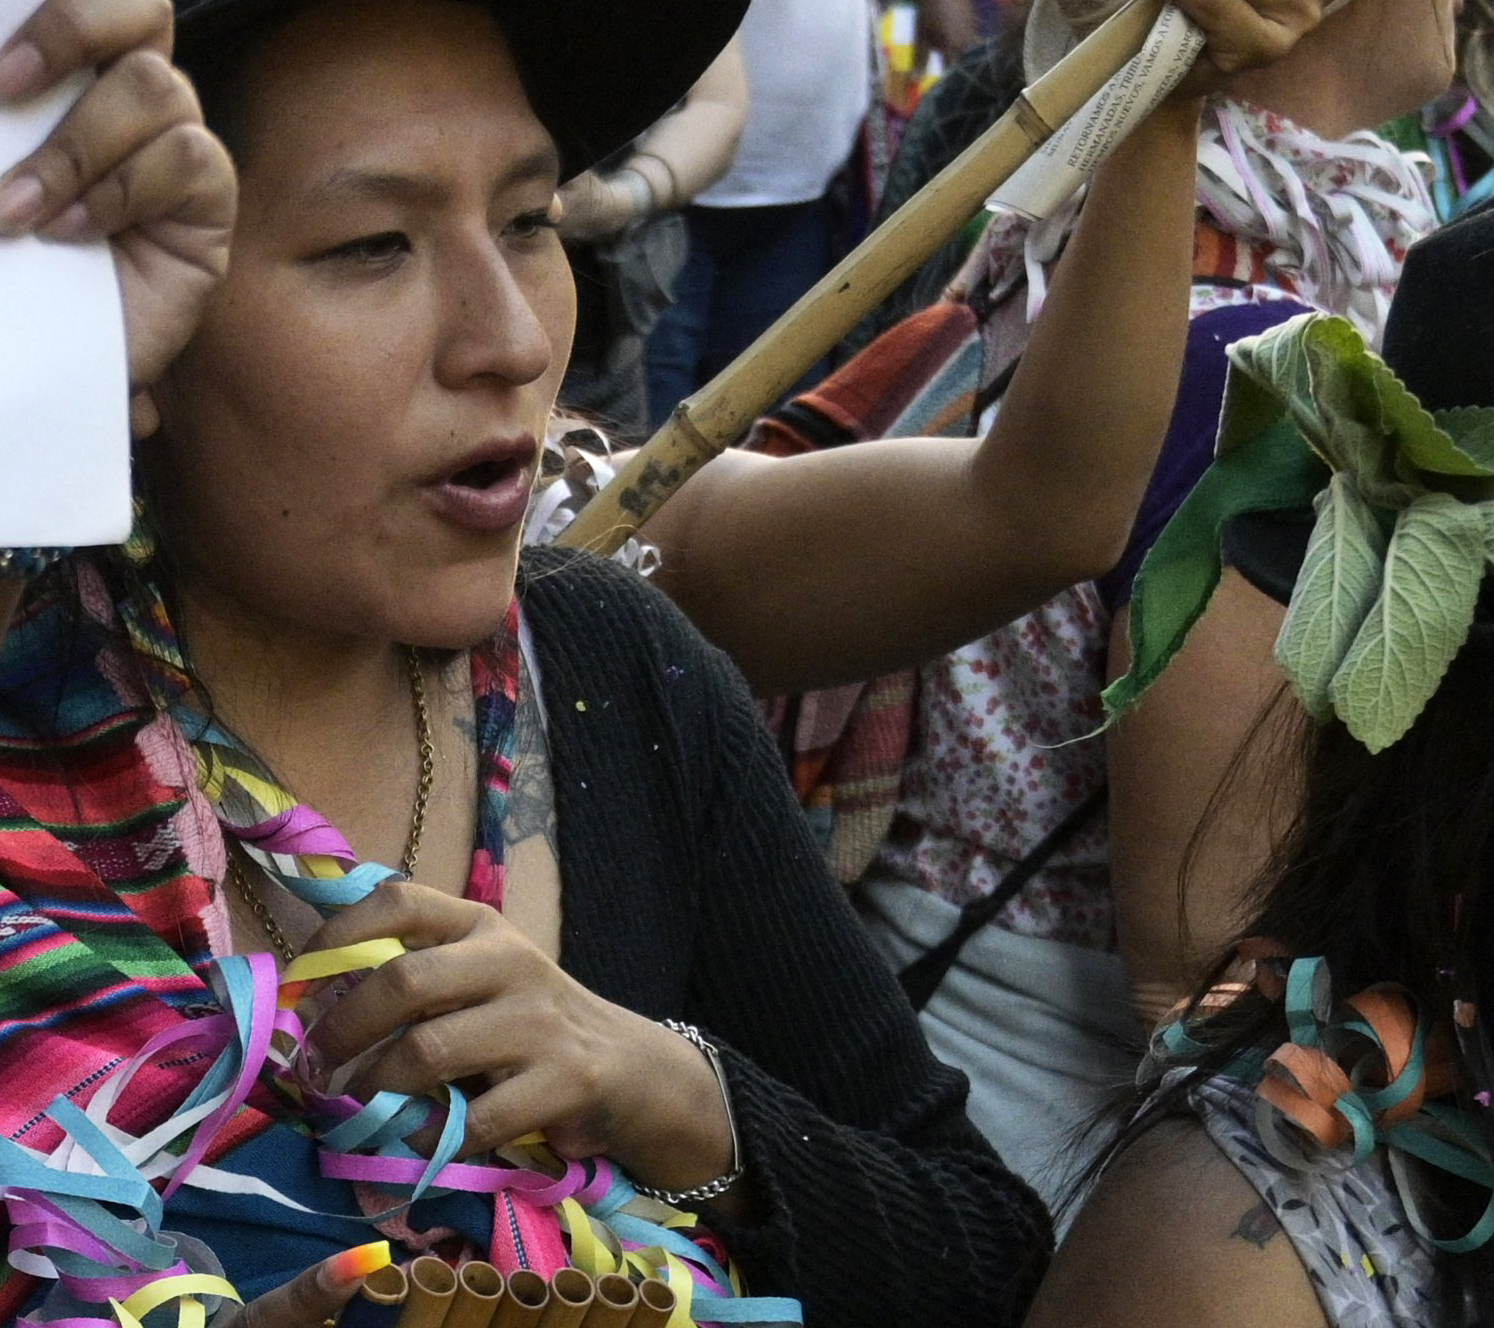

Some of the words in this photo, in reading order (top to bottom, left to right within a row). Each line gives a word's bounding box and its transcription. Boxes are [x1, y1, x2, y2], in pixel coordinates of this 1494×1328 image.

[1119, 56, 1142, 91] TRIBU
[1139, 38, 1162, 77] VAMOS
[1067, 91, 1110, 168] RETORNAMOS
